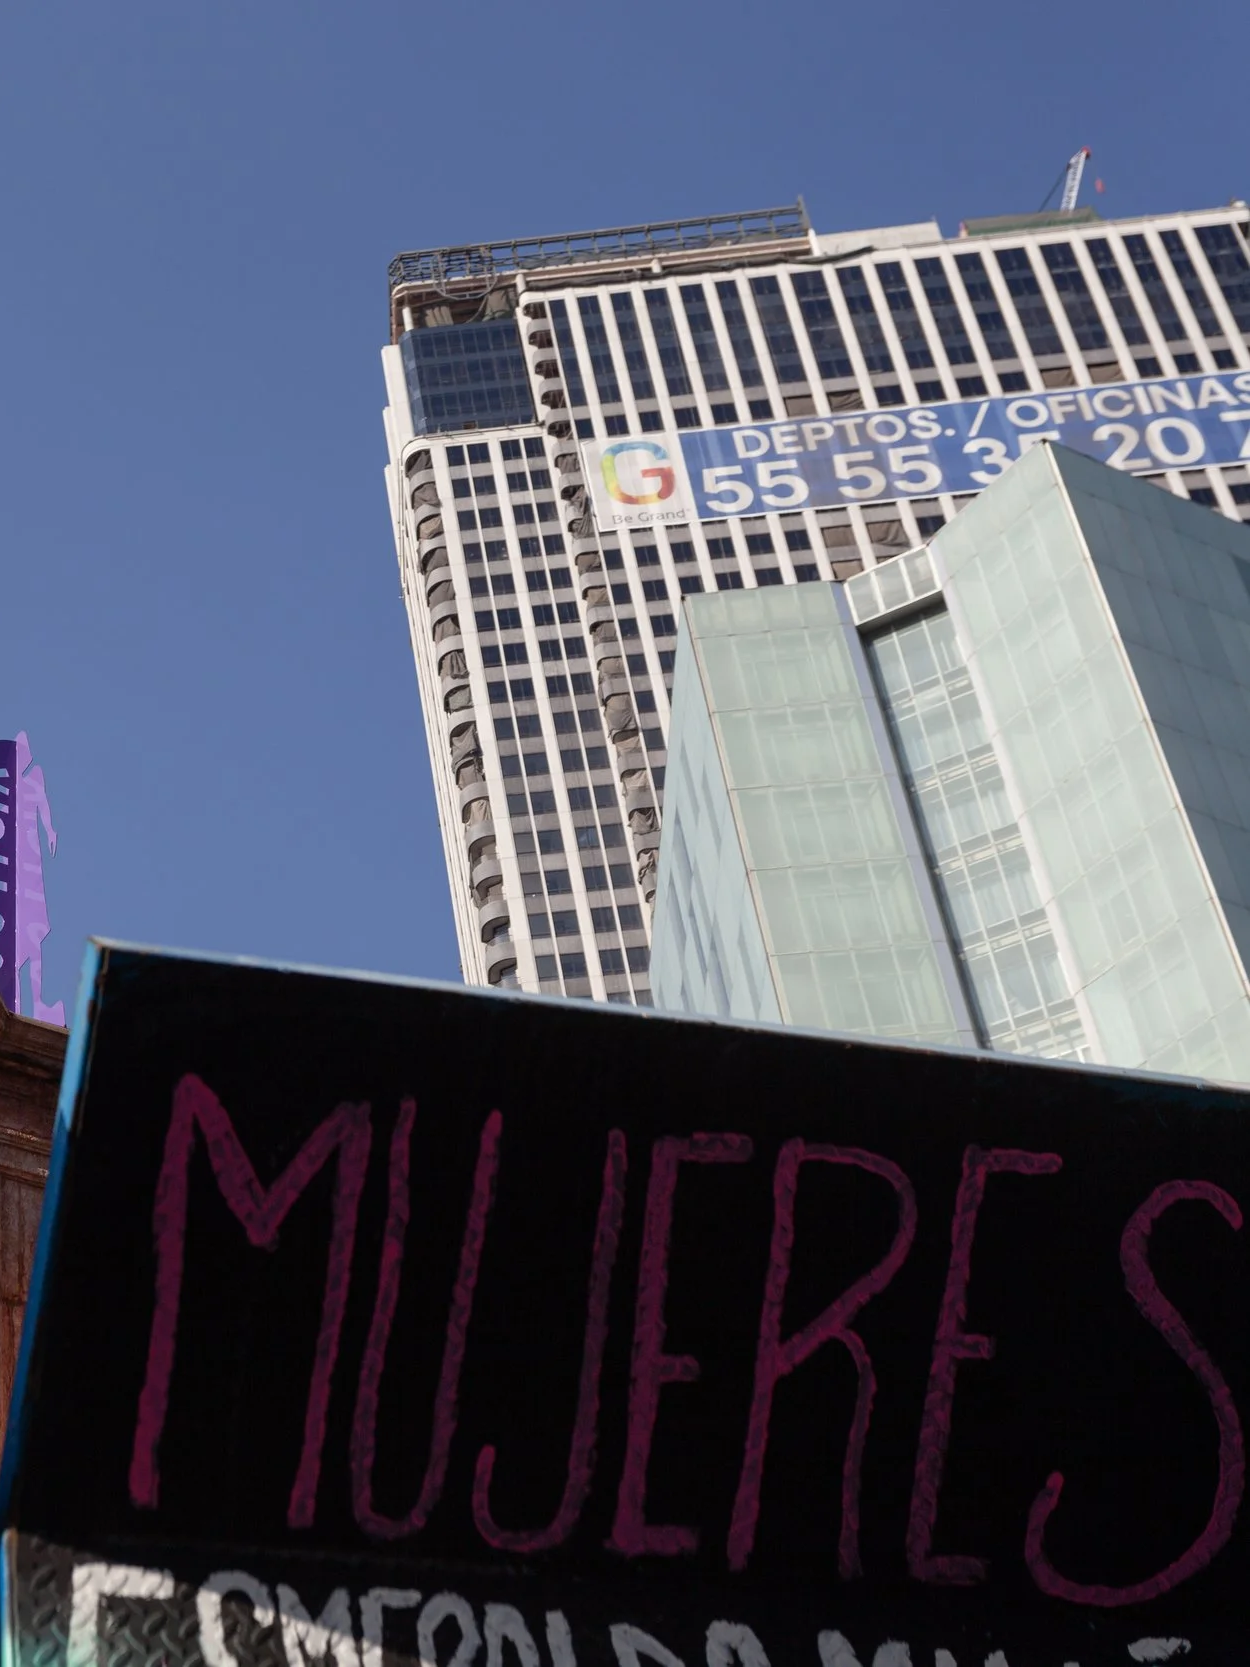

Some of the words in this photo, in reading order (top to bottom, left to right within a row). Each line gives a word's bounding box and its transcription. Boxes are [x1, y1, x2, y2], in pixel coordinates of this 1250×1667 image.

[732, 409, 957, 459] DEPTOS.
[968, 402, 990, 438] /
[601, 440, 676, 505] G
[702, 459, 810, 513] 55
[833, 444, 943, 499] 55
[1082, 417, 1206, 470] 20
[611, 514, 633, 525] Be
[637, 509, 686, 523] Grand
[128, 1072, 1245, 1607] MUJERES
